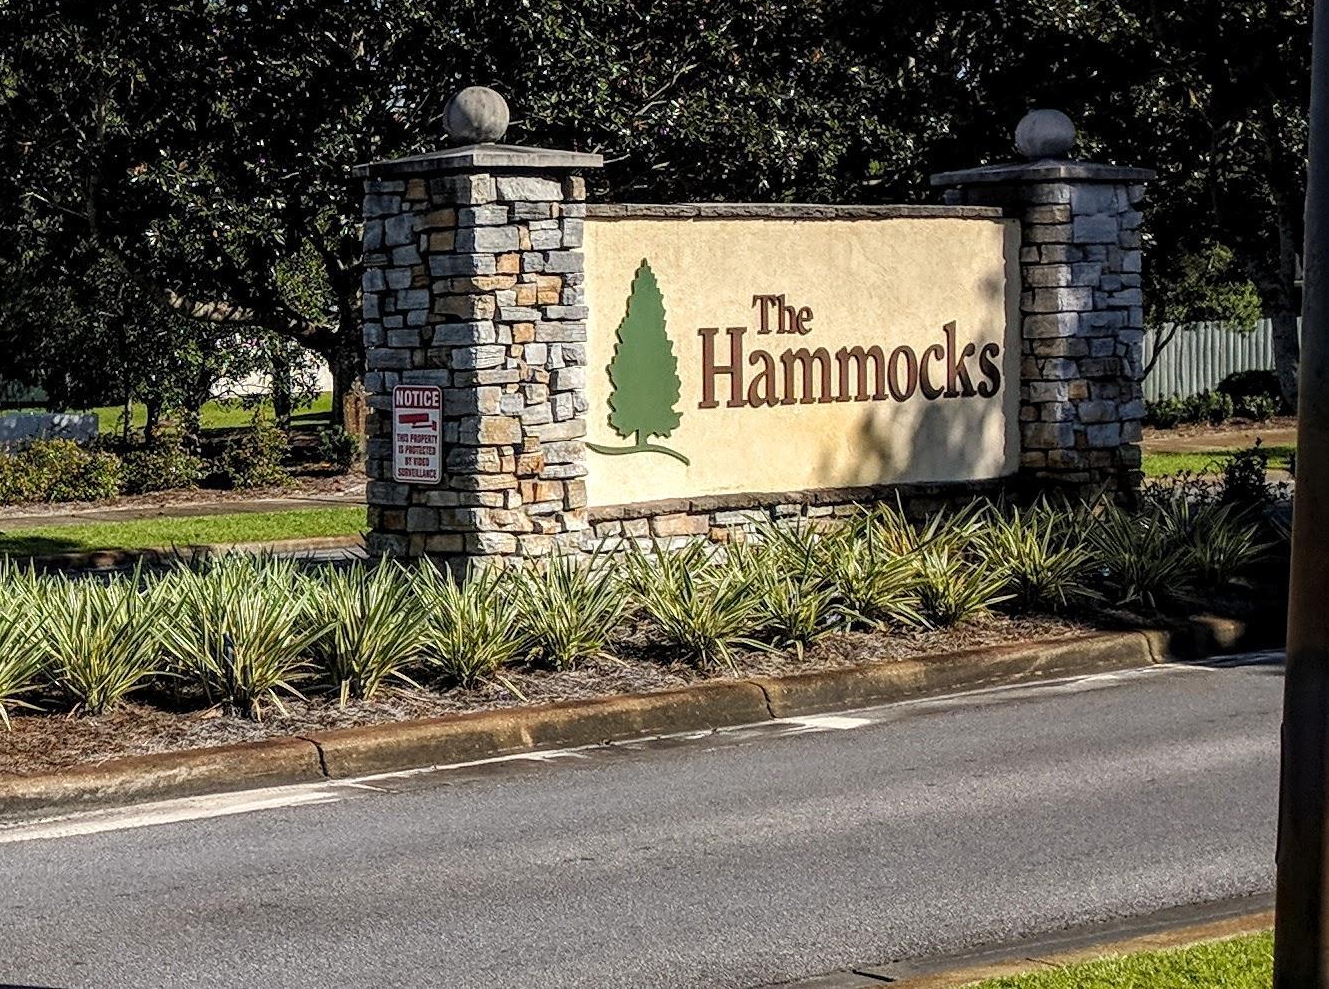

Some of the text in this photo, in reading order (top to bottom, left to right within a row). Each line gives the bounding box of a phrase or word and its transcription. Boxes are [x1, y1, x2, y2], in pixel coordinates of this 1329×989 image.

[751, 294, 814, 335] The
[697, 320, 1002, 409] Hammocks
[396, 389, 439, 407] NOTICE
[410, 433, 437, 444] PROPERTY
